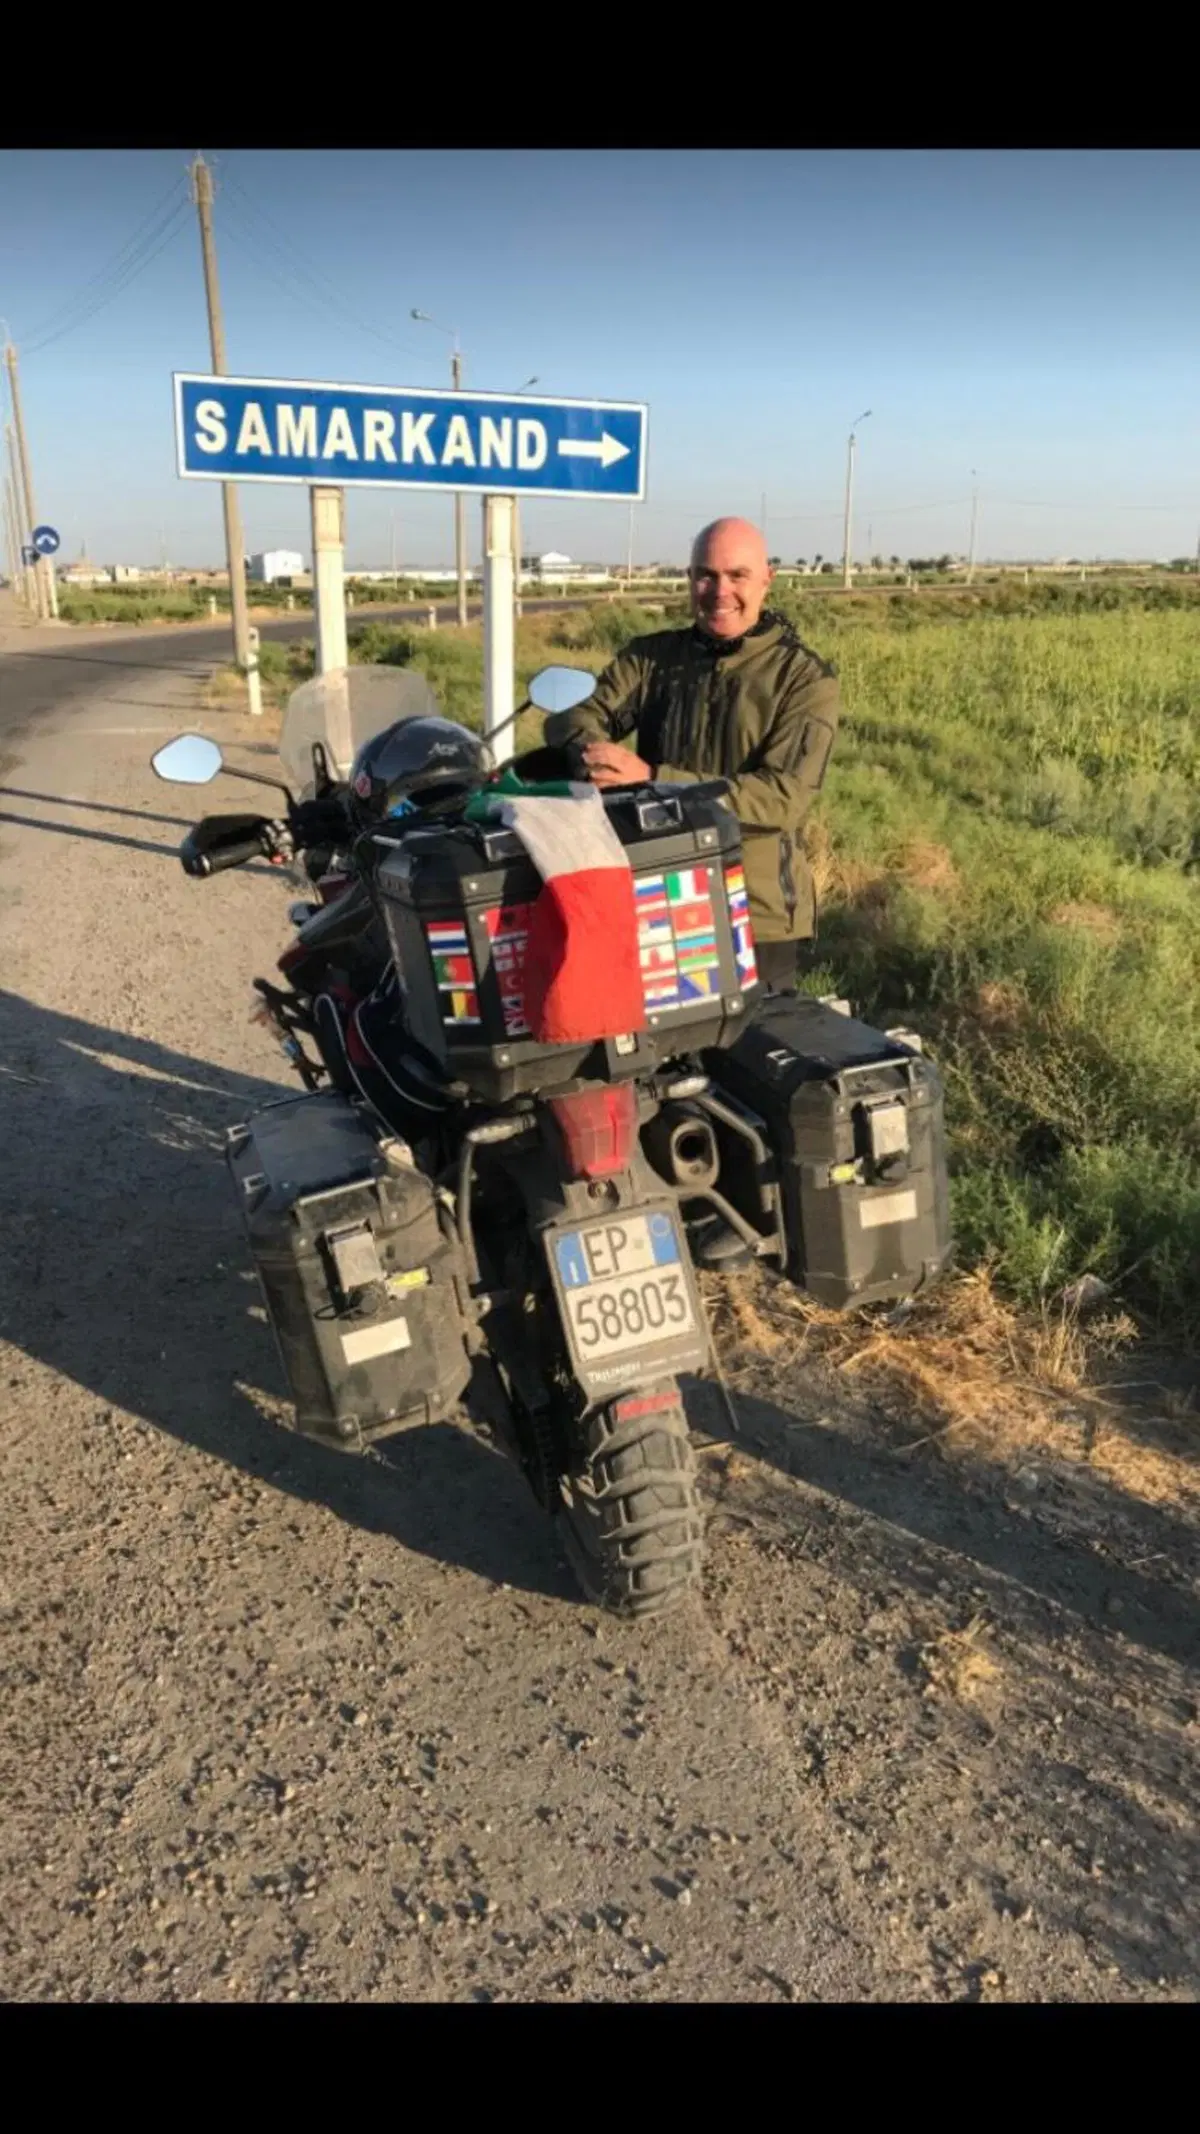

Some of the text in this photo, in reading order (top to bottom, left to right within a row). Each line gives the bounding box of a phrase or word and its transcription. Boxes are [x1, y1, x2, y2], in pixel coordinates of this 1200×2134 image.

[195, 399, 547, 470] SAMARKAND
[583, 1226, 628, 1277] EP
[576, 1275, 687, 1346] 58803
